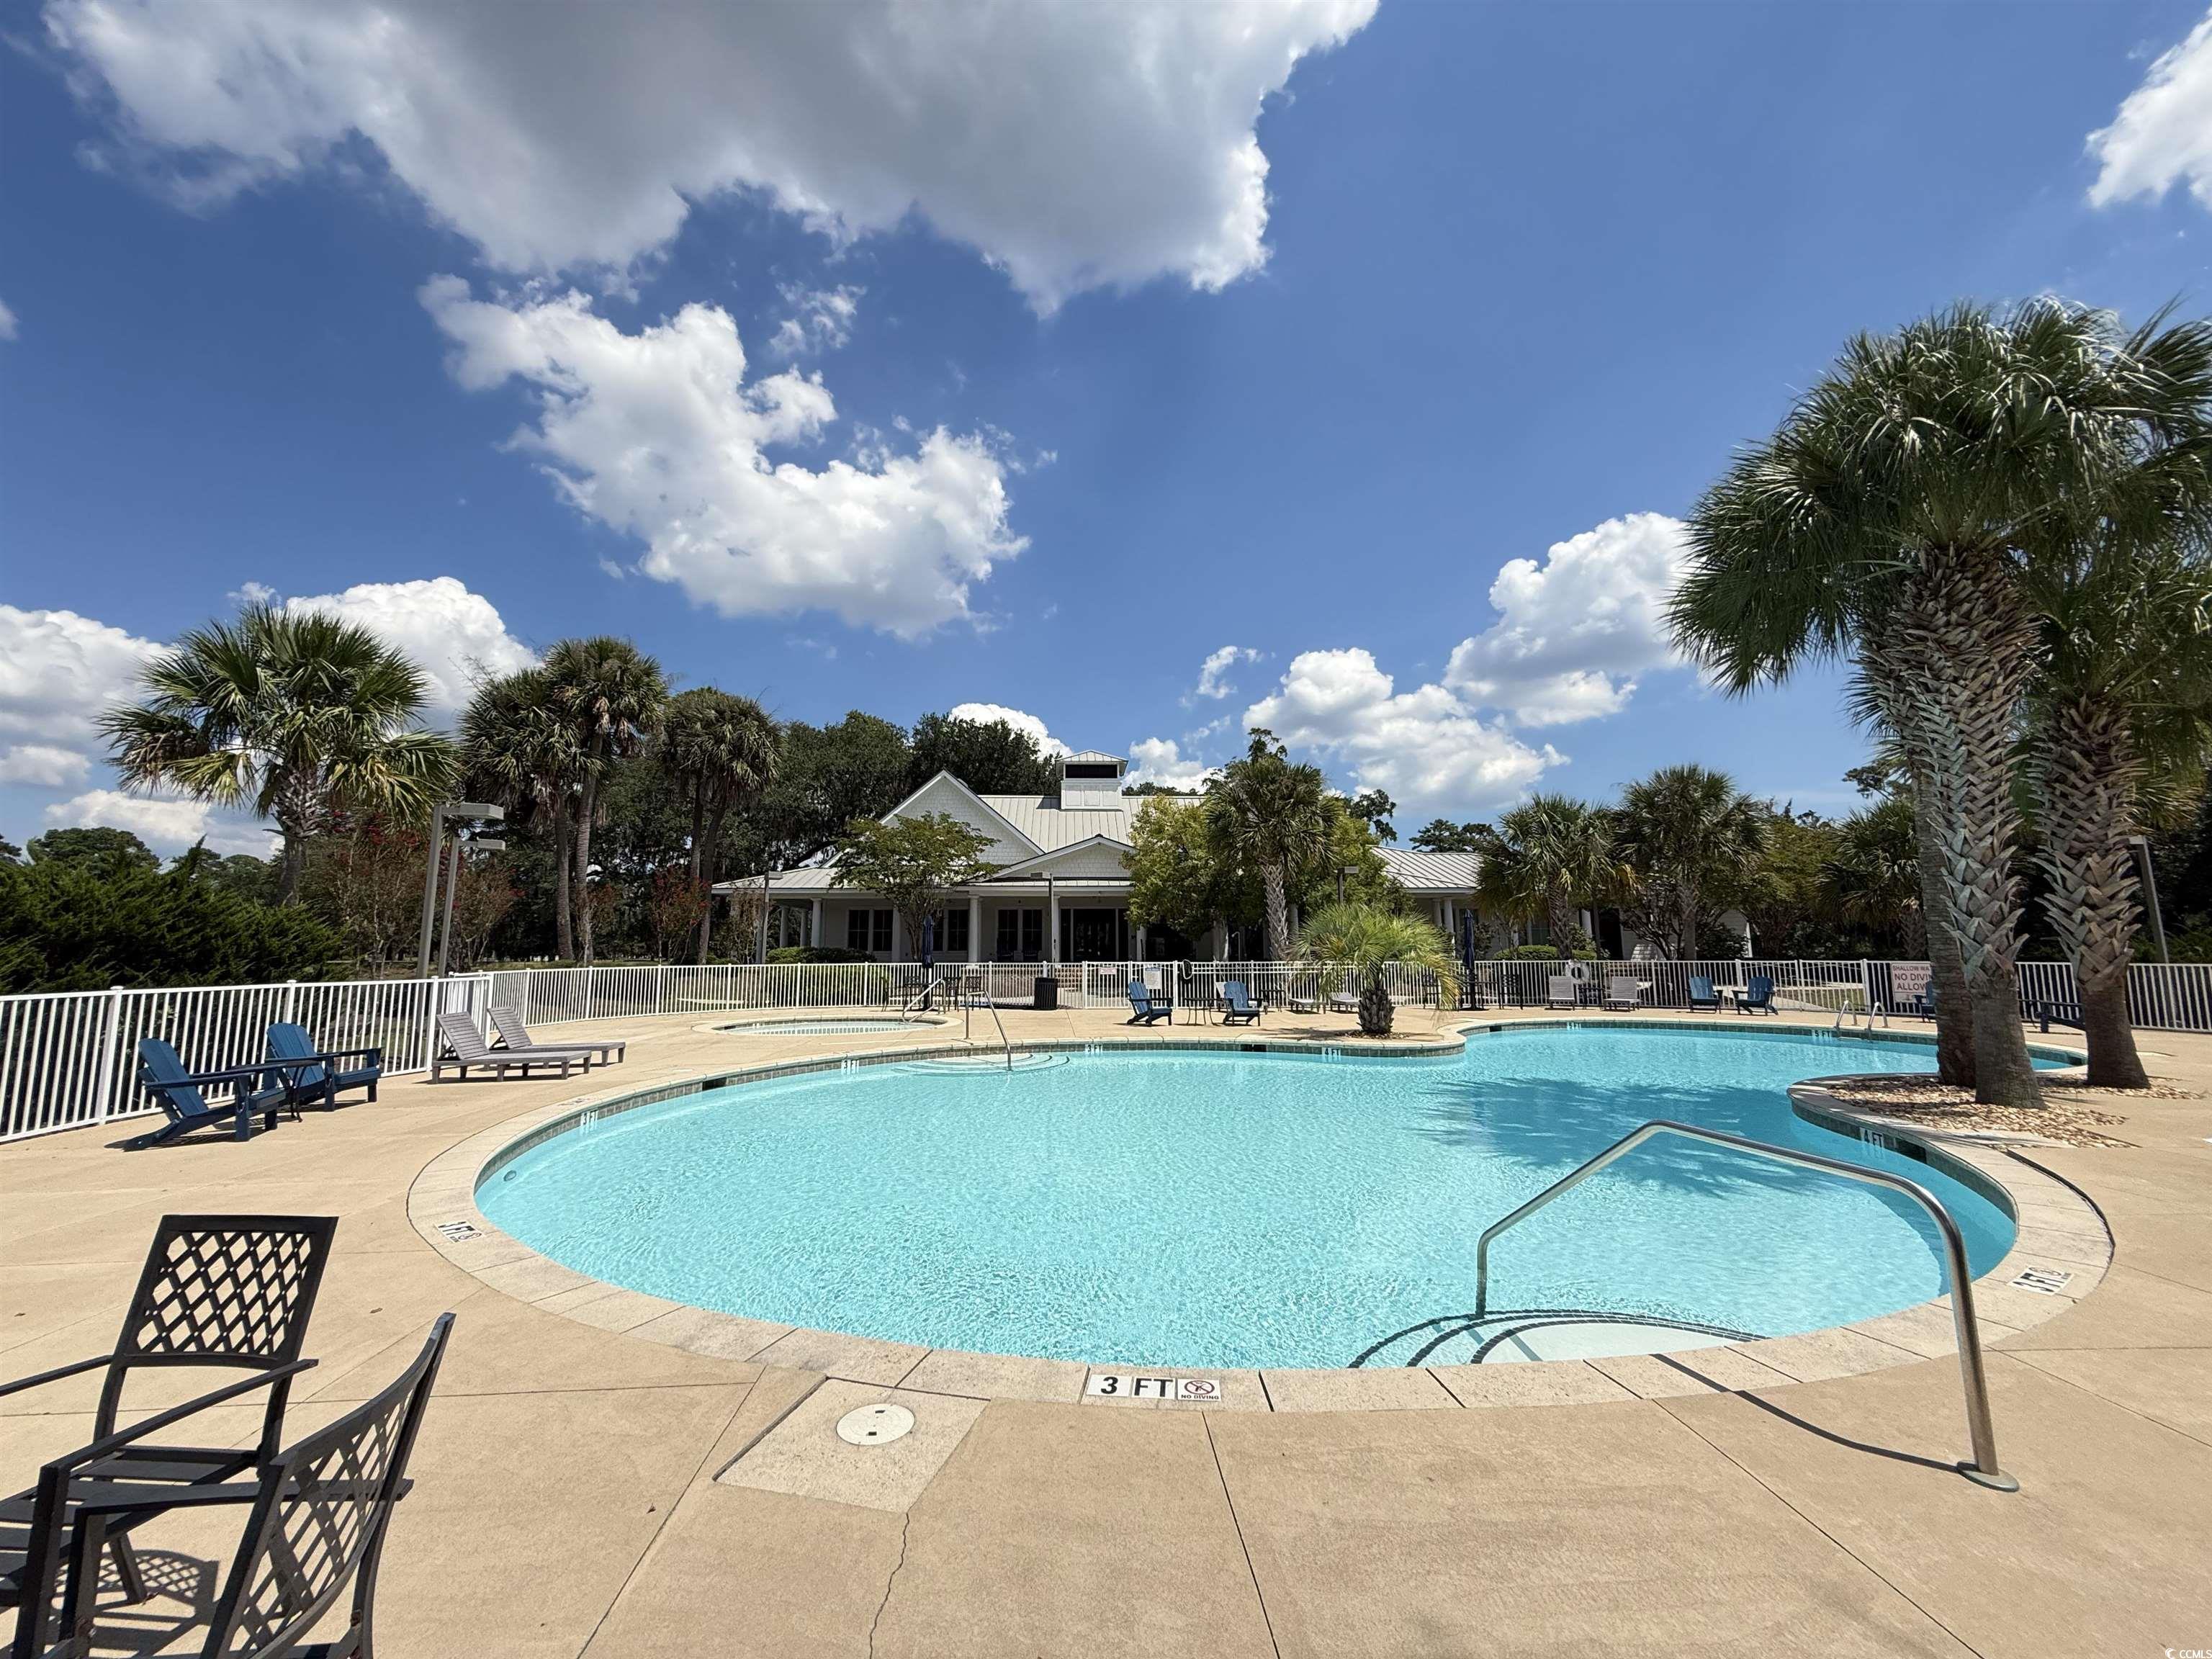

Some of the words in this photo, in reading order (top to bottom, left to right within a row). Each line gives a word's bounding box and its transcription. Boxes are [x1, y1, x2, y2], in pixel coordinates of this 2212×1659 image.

[850, 1059, 859, 1069] FT
[589, 1110, 599, 1123] FT
[1864, 1129, 1870, 1143] 4
[1872, 1132, 1883, 1148] FT
[1100, 1376, 1119, 1395] 3
[1134, 1377, 1174, 1398] FT
